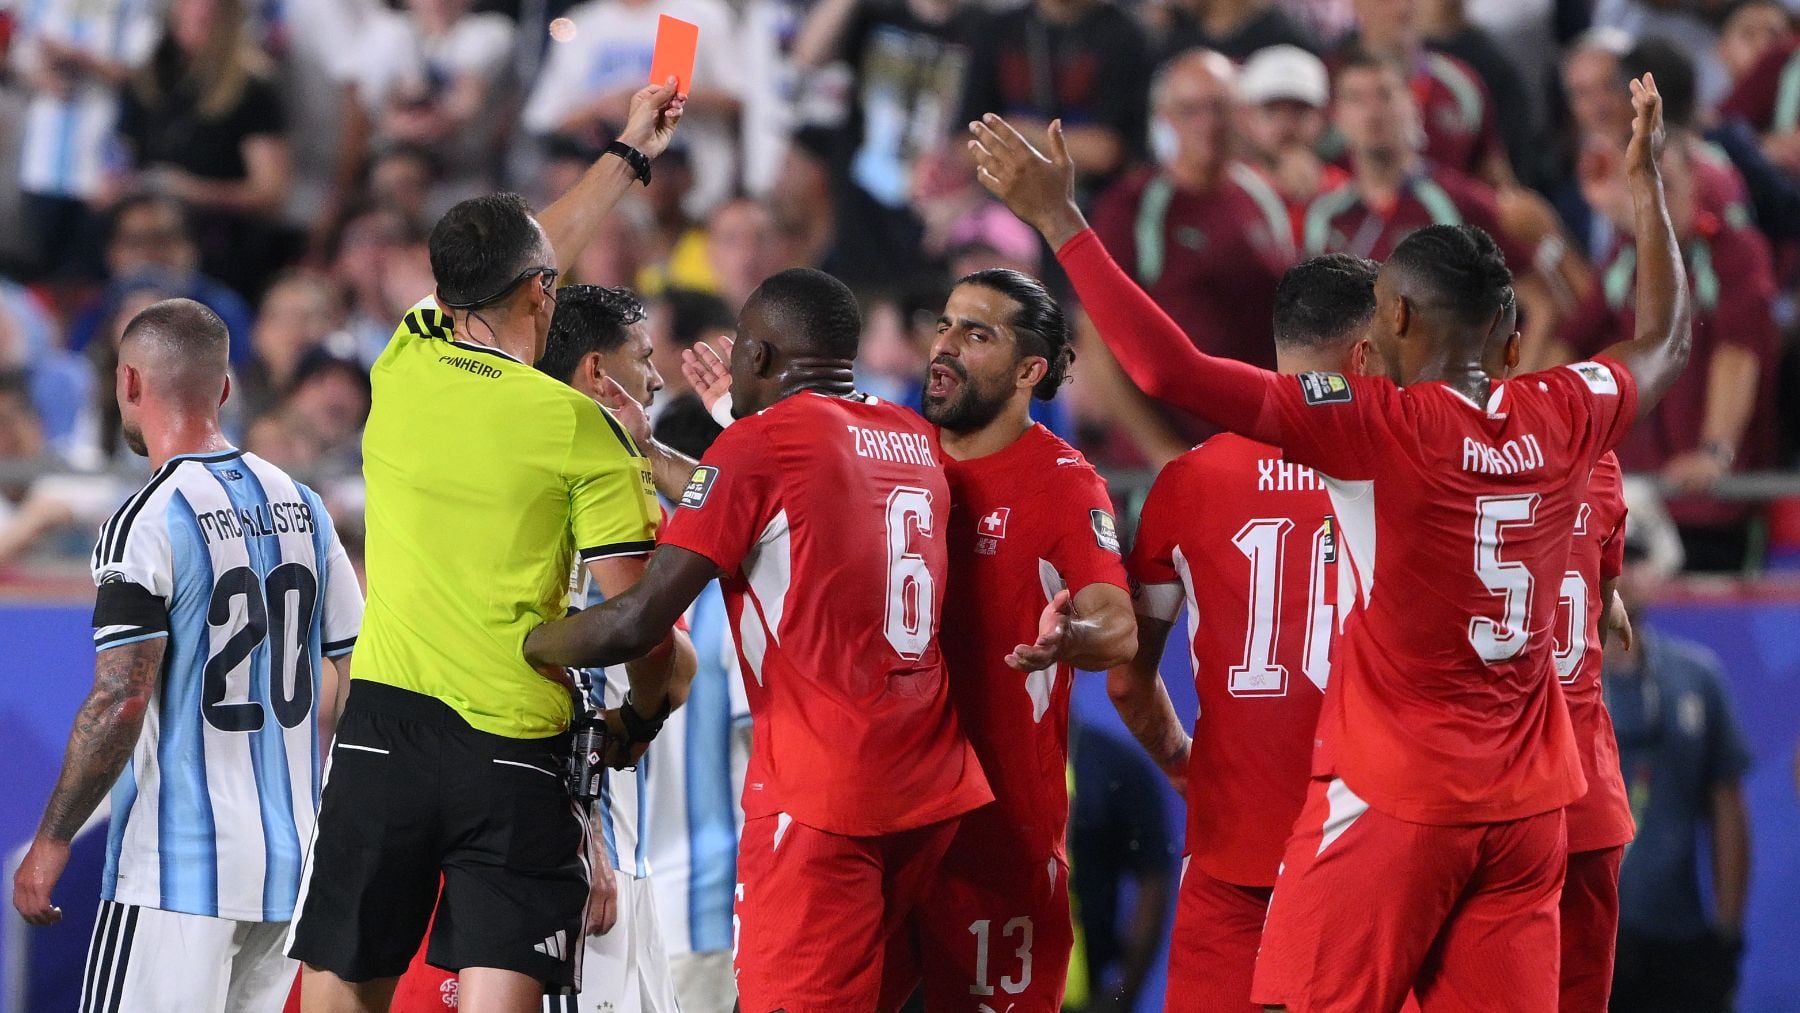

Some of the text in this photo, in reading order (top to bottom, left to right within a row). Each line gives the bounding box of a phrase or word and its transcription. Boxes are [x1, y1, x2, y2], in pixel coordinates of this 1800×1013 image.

[438, 355, 503, 379] PINHEIRO
[846, 424, 937, 468] ZAKARIA
[1462, 433, 1545, 475] AKANJI
[196, 501, 315, 545] MAC ALISTER
[884, 486, 936, 662] 6
[1468, 492, 1543, 667] 5
[200, 562, 319, 733] 20
[967, 915, 1035, 997] 13
